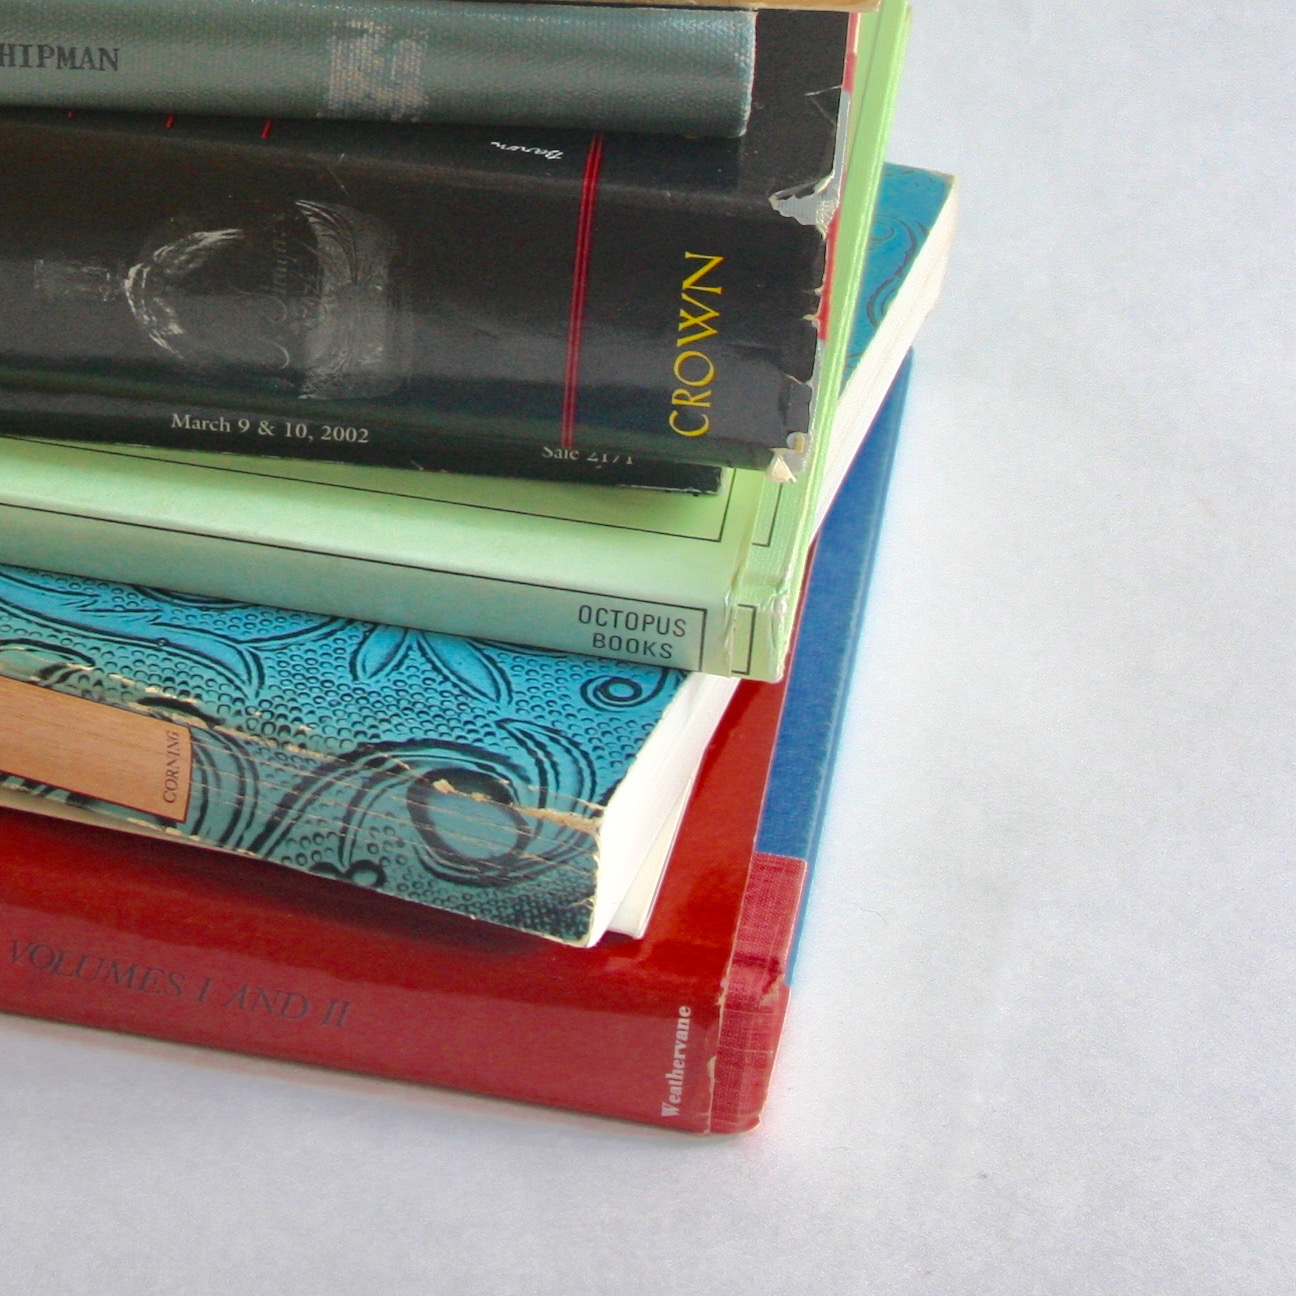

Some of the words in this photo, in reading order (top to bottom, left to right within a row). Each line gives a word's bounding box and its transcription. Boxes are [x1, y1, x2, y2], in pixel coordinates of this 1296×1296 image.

[669, 250, 724, 437] CROWN
[171, 413, 231, 434] March
[238, 418, 251, 434] 9
[257, 420, 275, 437] &
[283, 422, 313, 443] 10,
[320, 425, 370, 444] 2002
[578, 604, 687, 638] OCTOPUS
[592, 632, 674, 660] BOOKS
[163, 730, 180, 804] CORNING
[8, 939, 189, 998] VOLUMES
[221, 983, 310, 1020] AND
[321, 1000, 351, 1028] II
[660, 1005, 692, 1118] Weathervane
